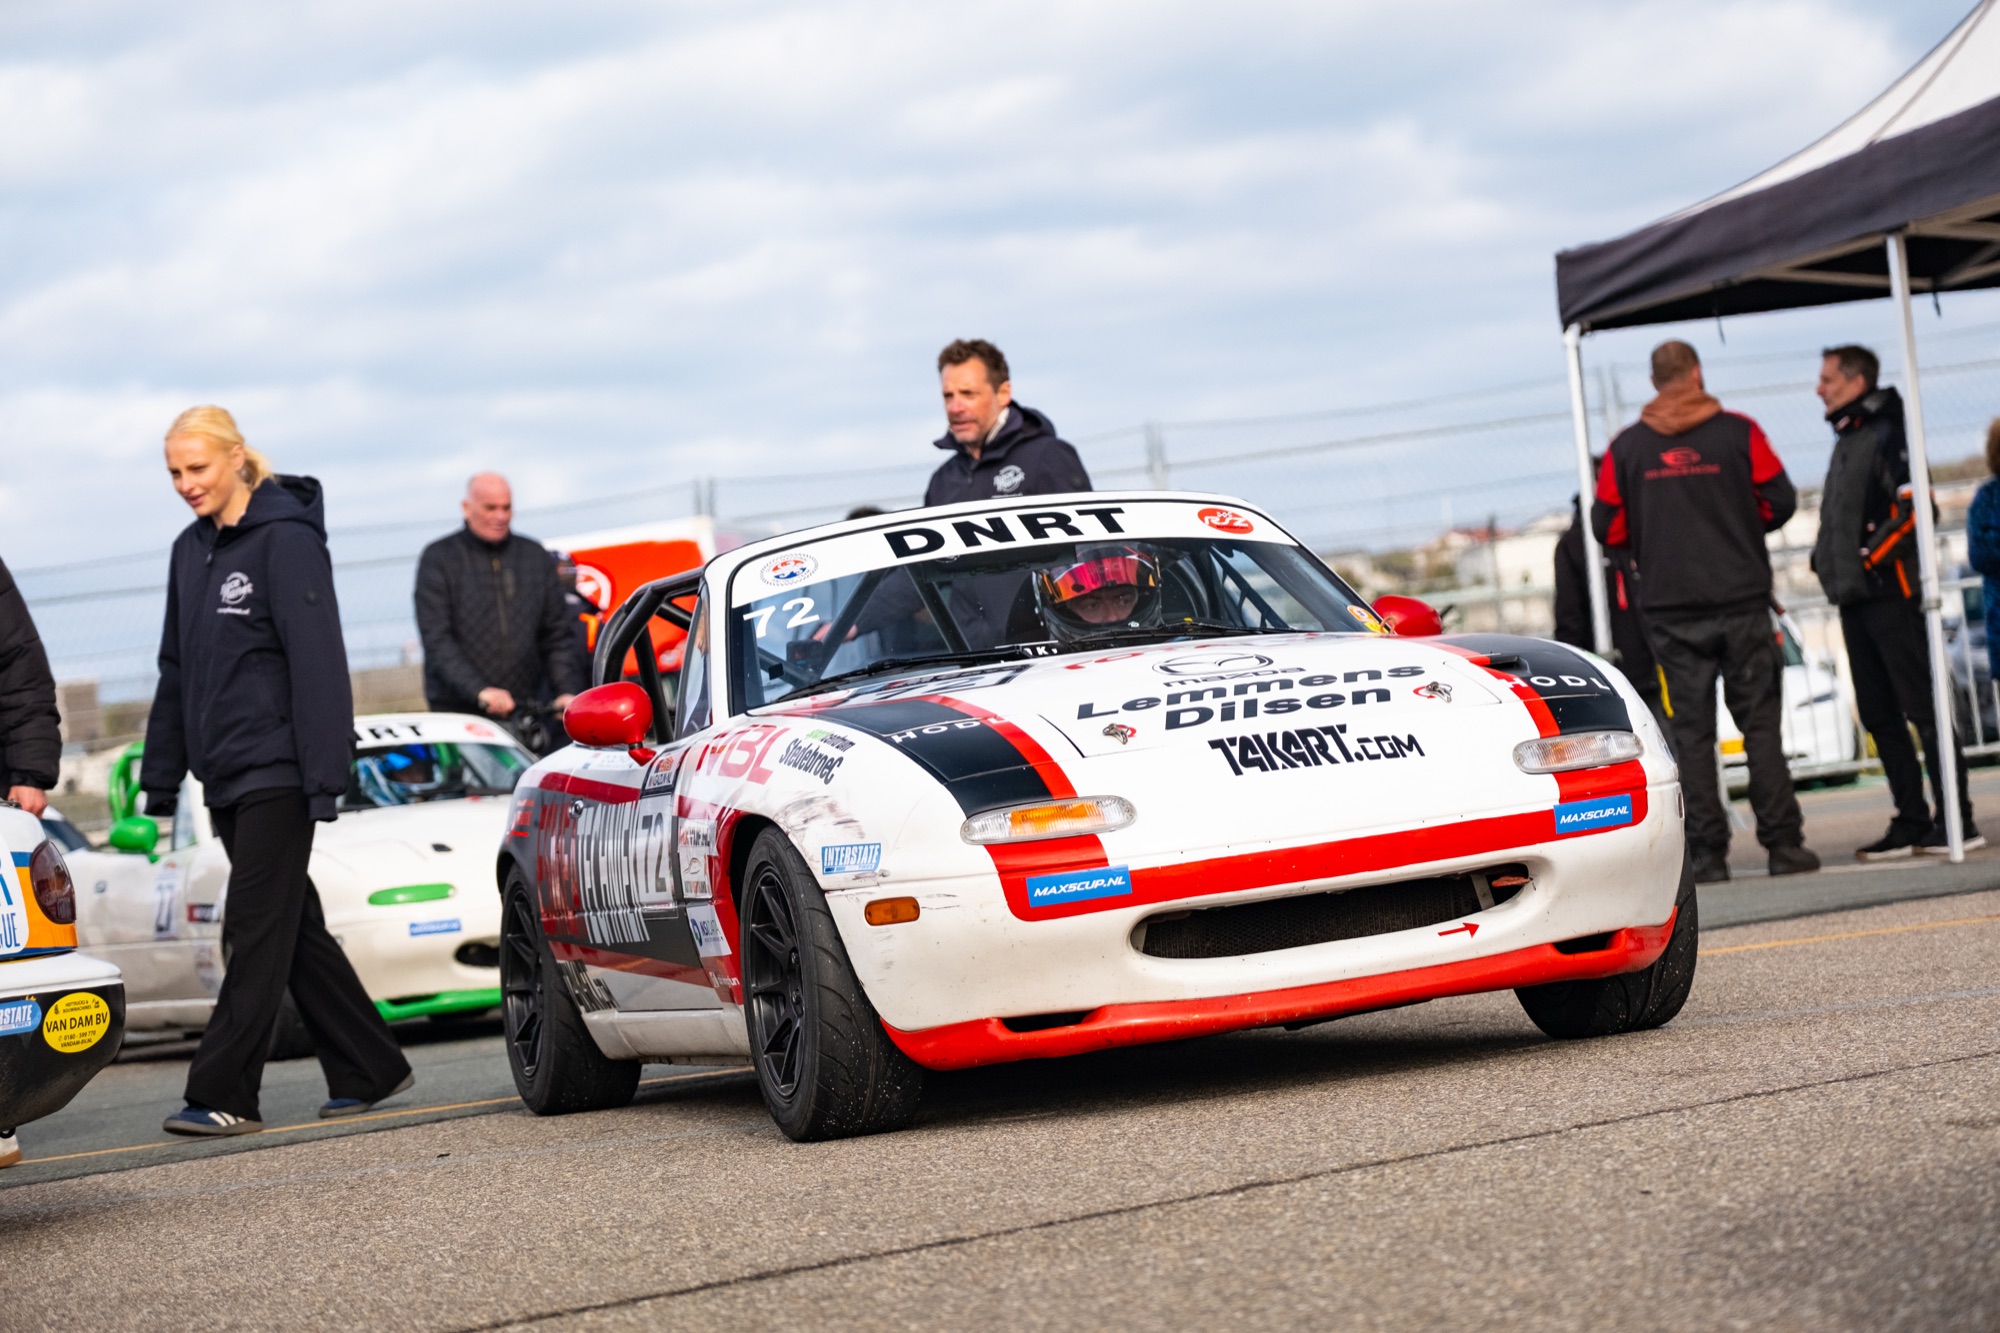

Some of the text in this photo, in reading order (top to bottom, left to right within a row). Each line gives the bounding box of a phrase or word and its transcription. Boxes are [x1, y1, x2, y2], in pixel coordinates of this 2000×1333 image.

[884, 507, 1125, 559] DNRT
[743, 597, 820, 638] 72
[1163, 667, 1306, 687] mazda
[1505, 675, 1611, 691] HODL
[1077, 666, 1425, 720] Lemmens
[1165, 688, 1391, 730] Dilsen
[891, 716, 1008, 744] HODL
[1559, 805, 1630, 825] MAX5CUP.NL
[641, 812, 667, 893] 72
[824, 845, 880, 866] INTERSTATE
[1033, 876, 1126, 898] MAX5CUP.NL
[45, 1011, 108, 1033] VAN DAM BV
